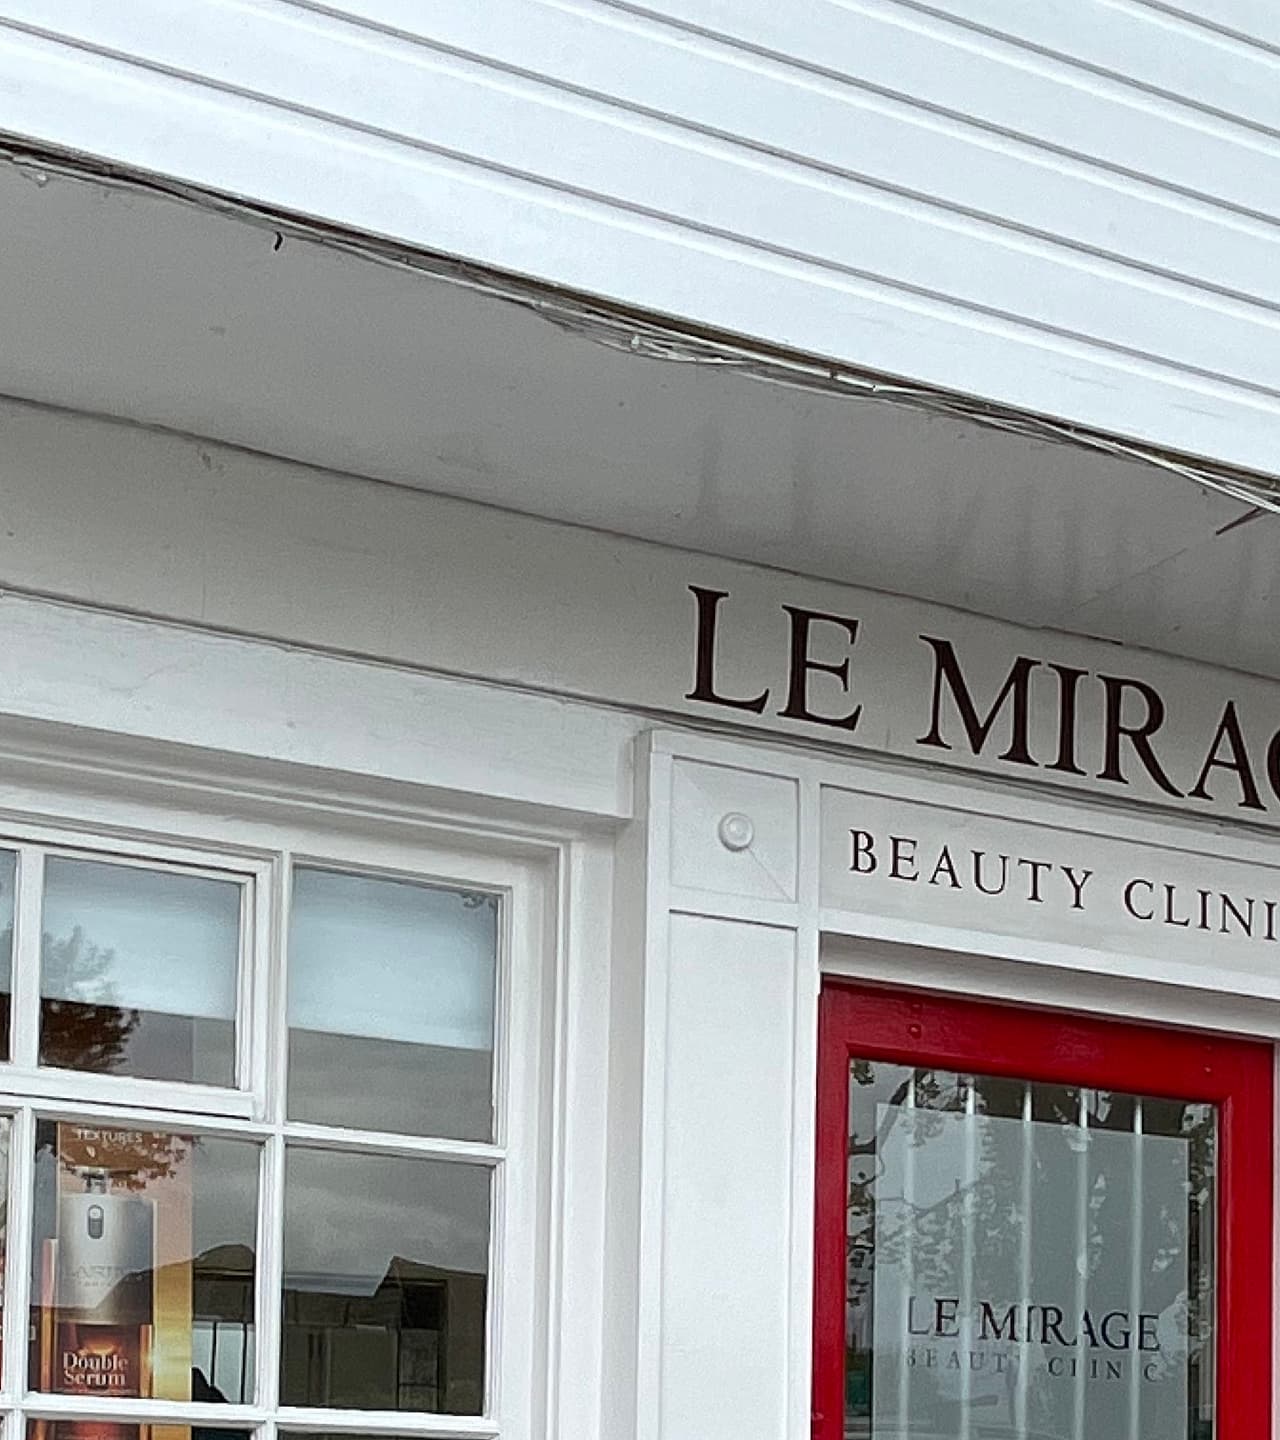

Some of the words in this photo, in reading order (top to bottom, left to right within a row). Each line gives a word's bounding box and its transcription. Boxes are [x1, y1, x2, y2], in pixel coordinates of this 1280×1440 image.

[685, 585, 863, 732] LE
[848, 827, 1094, 910] BEAUTY
[907, 1296, 960, 1337] LE
[977, 1301, 1162, 1352] MIRAGE
[63, 1352, 128, 1372] Double
[63, 1369, 126, 1386] Serum
